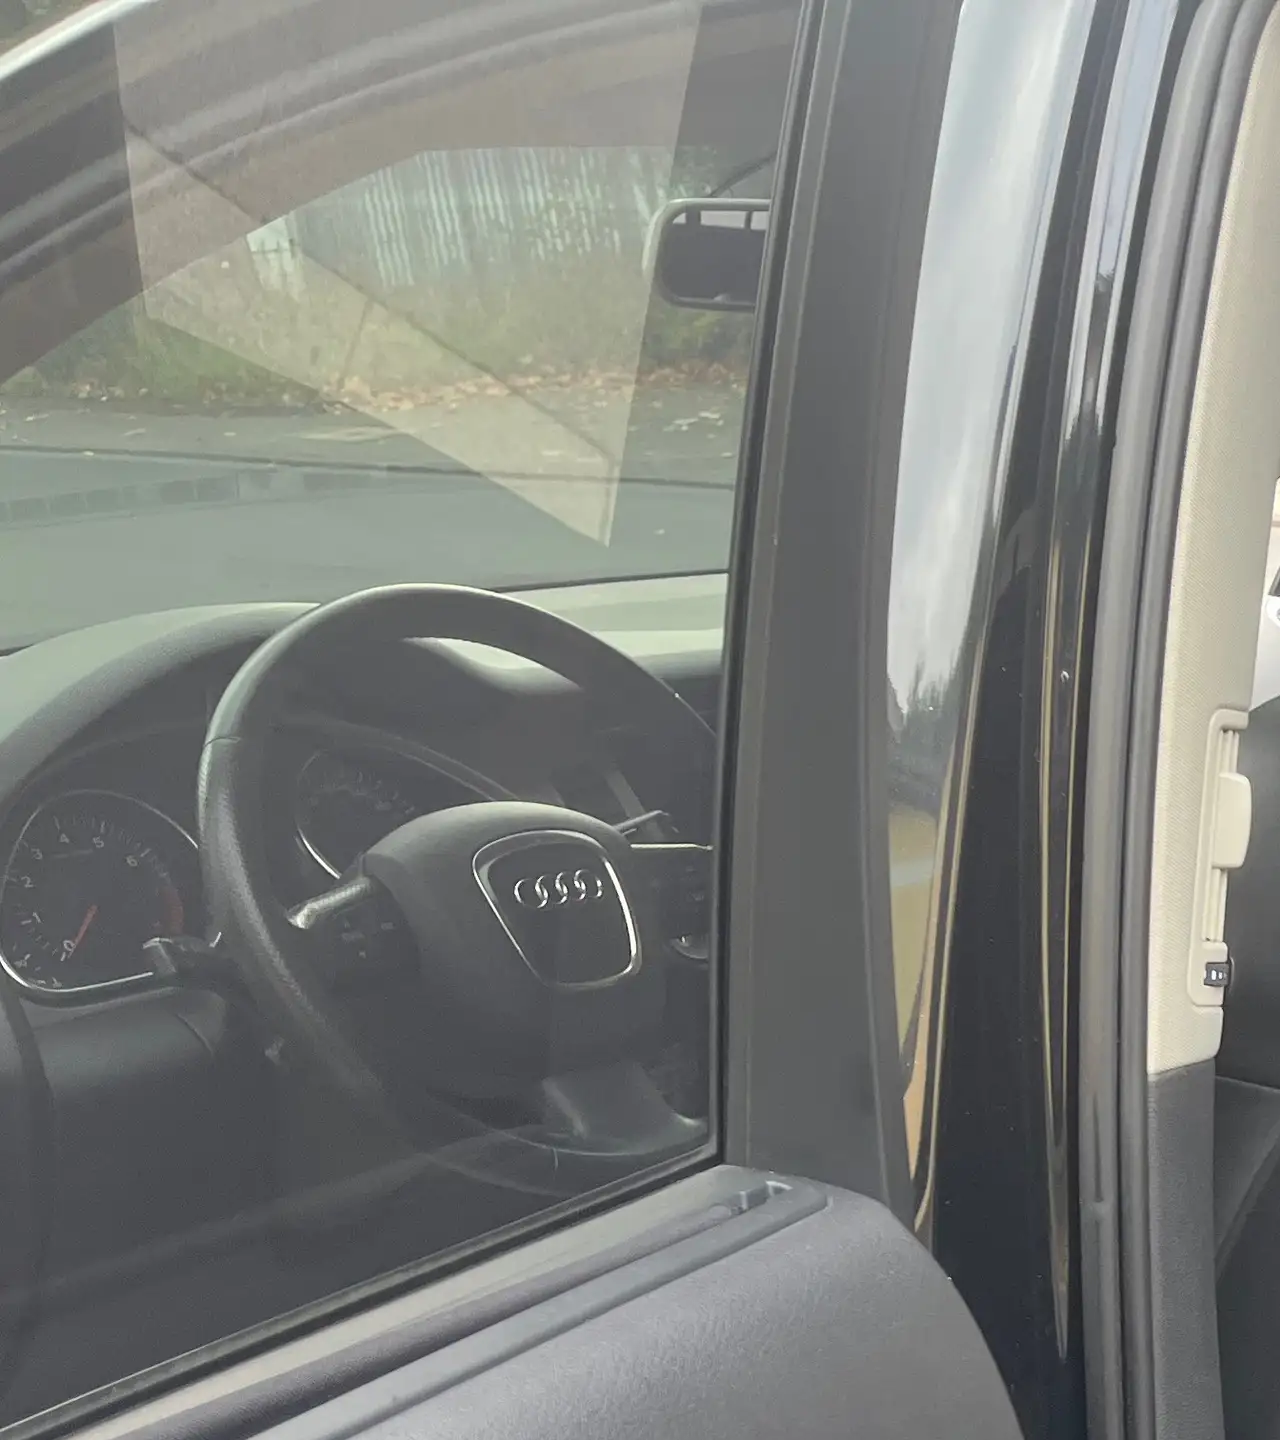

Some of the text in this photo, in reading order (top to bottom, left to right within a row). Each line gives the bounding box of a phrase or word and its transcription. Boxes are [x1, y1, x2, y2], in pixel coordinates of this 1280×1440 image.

[92, 836, 105, 849] 5
[125, 855, 139, 867] 6
[21, 876, 35, 888] 2
